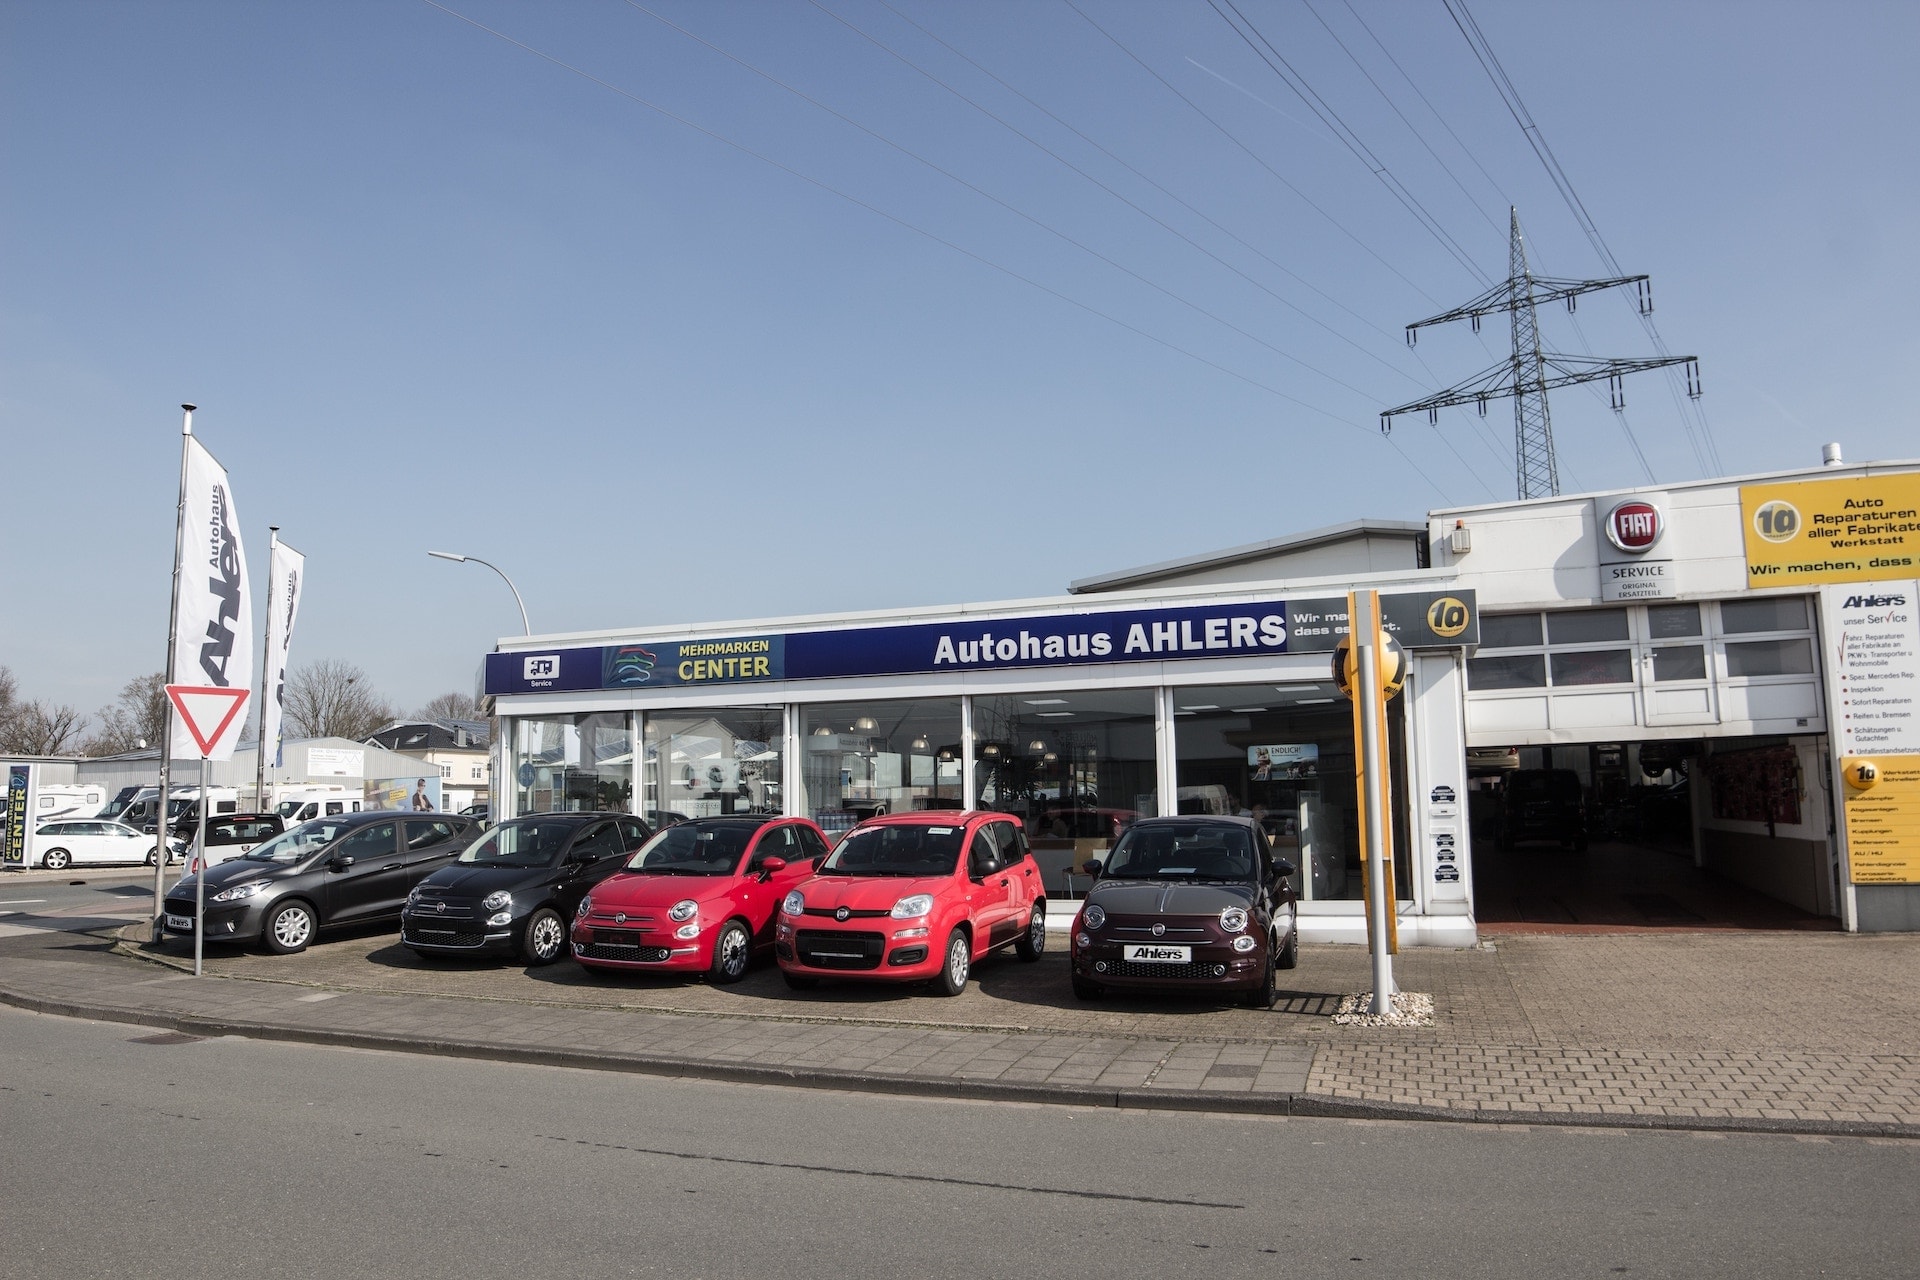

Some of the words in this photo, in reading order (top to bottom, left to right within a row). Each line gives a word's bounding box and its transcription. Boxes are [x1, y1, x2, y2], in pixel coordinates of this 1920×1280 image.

[1844, 498, 1884, 510] Auto
[1758, 505, 1796, 534] 1a
[1814, 509, 1917, 526] Reparaturen
[209, 484, 219, 569] Autohaus
[1620, 513, 1653, 538] FIAT
[1808, 527, 1841, 539] aller
[1831, 536, 1905, 549] Werkstatt
[1613, 566, 1664, 579] SERVICE
[1750, 564, 1781, 576] Wir
[1788, 560, 1862, 574] machen,
[1869, 557, 1912, 568] dass
[1622, 582, 1657, 590] ORIGINAL
[1618, 590, 1662, 598] ERSATZTEILE
[1842, 594, 1906, 609] Ahlers
[1293, 613, 1320, 624] Wir
[1431, 601, 1465, 628] 1a
[1843, 618, 1865, 626] unser
[1867, 611, 1907, 625] Service
[1294, 626, 1330, 637] dass
[1334, 626, 1351, 634] es
[933, 630, 1112, 665] Autohaus
[1124, 615, 1287, 654] AHLERS
[679, 640, 769, 657] MEHRMARKEN
[678, 656, 771, 681] CENTER
[1868, 672, 1900, 680] Mercedes
[531, 680, 553, 688] Service
[1851, 686, 1884, 694] Inspektion
[1271, 746, 1301, 754] ENDLICH!
[1857, 766, 1875, 780] 1a
[6, 788, 15, 860] MEHRMARKEN
[12, 788, 26, 861] CENTER
[1133, 947, 1183, 960] Ahlers
